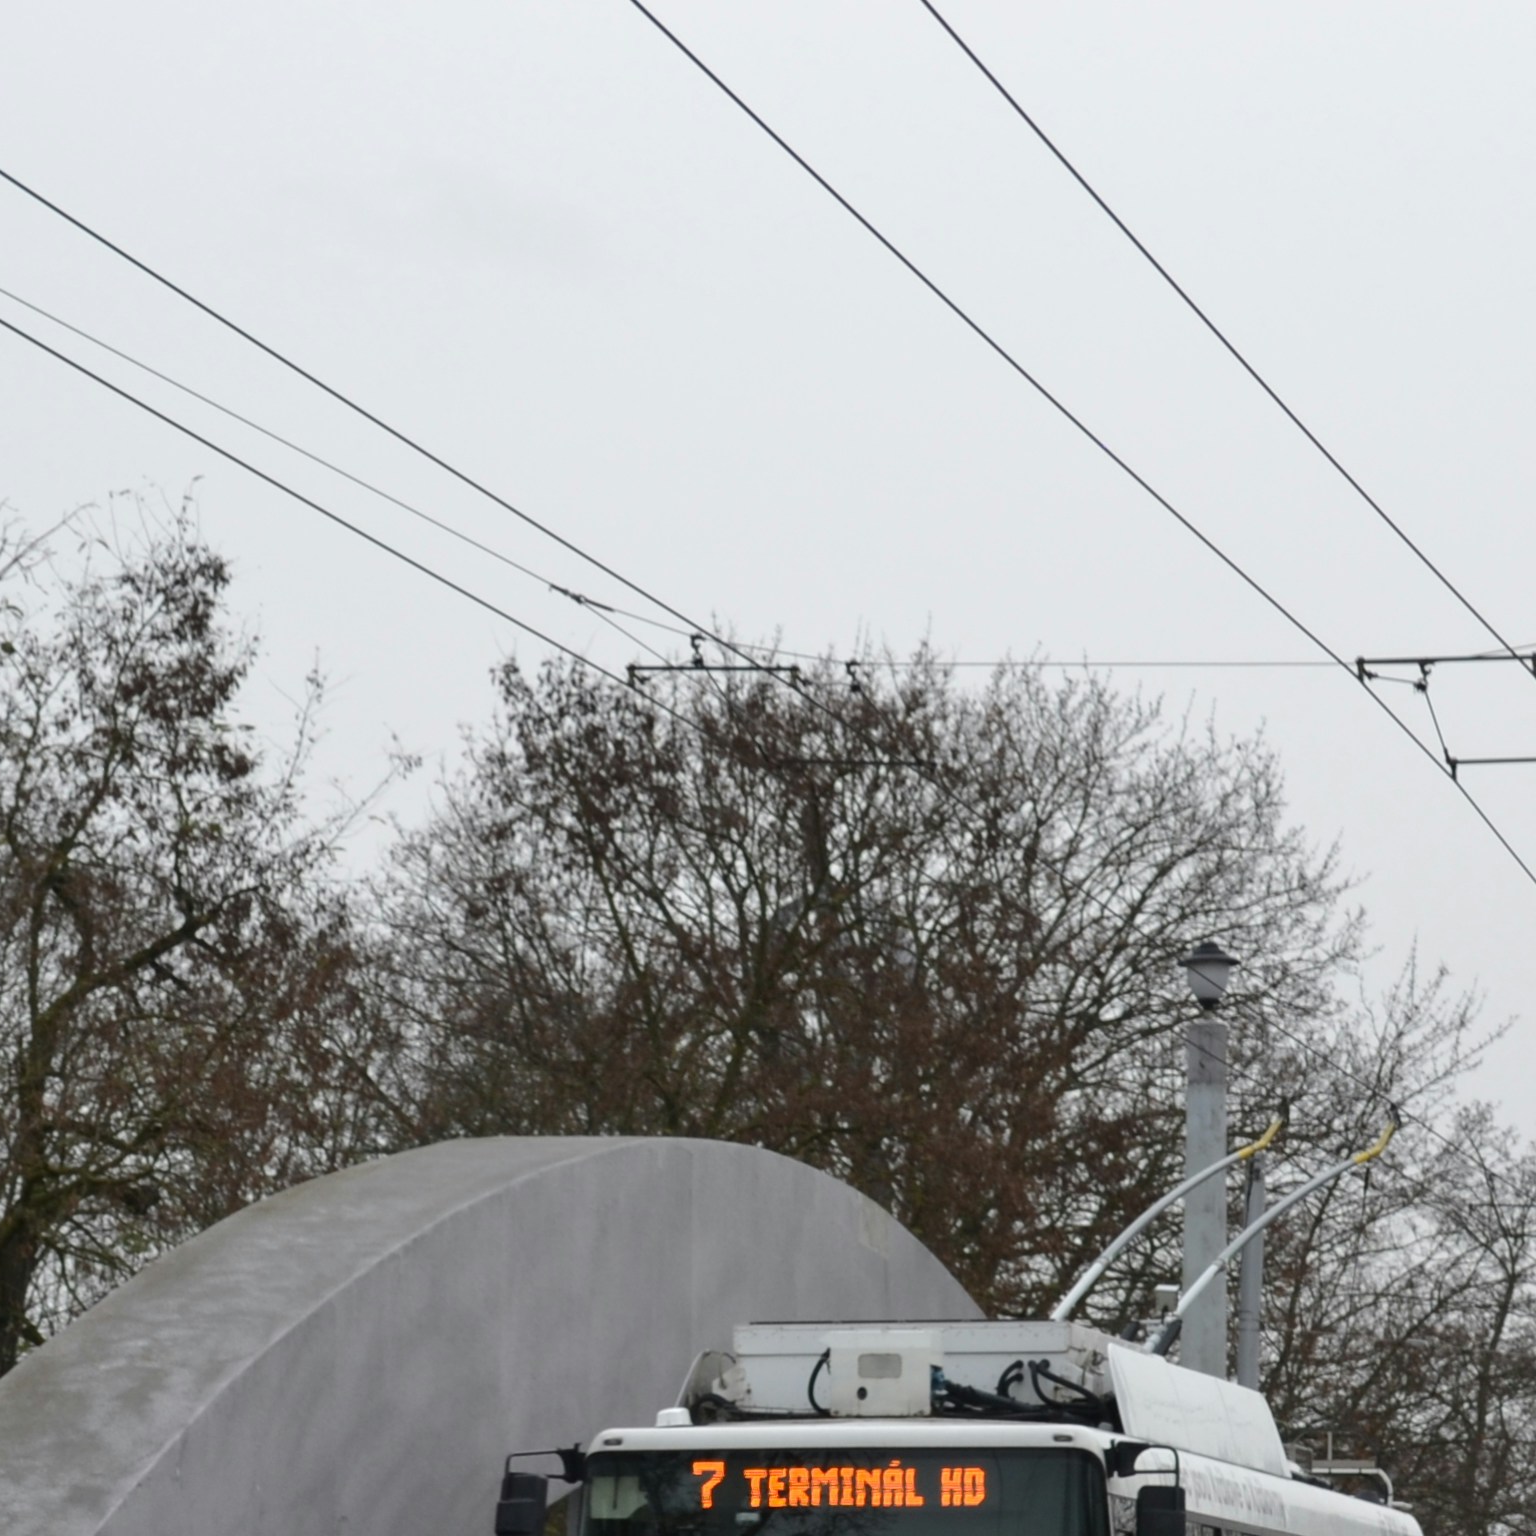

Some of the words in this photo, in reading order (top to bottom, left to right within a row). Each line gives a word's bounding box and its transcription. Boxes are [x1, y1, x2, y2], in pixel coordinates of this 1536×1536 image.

[693, 1462, 725, 1509] 7
[743, 1459, 925, 1507] TERMINÁL
[940, 1467, 986, 1507] HD
